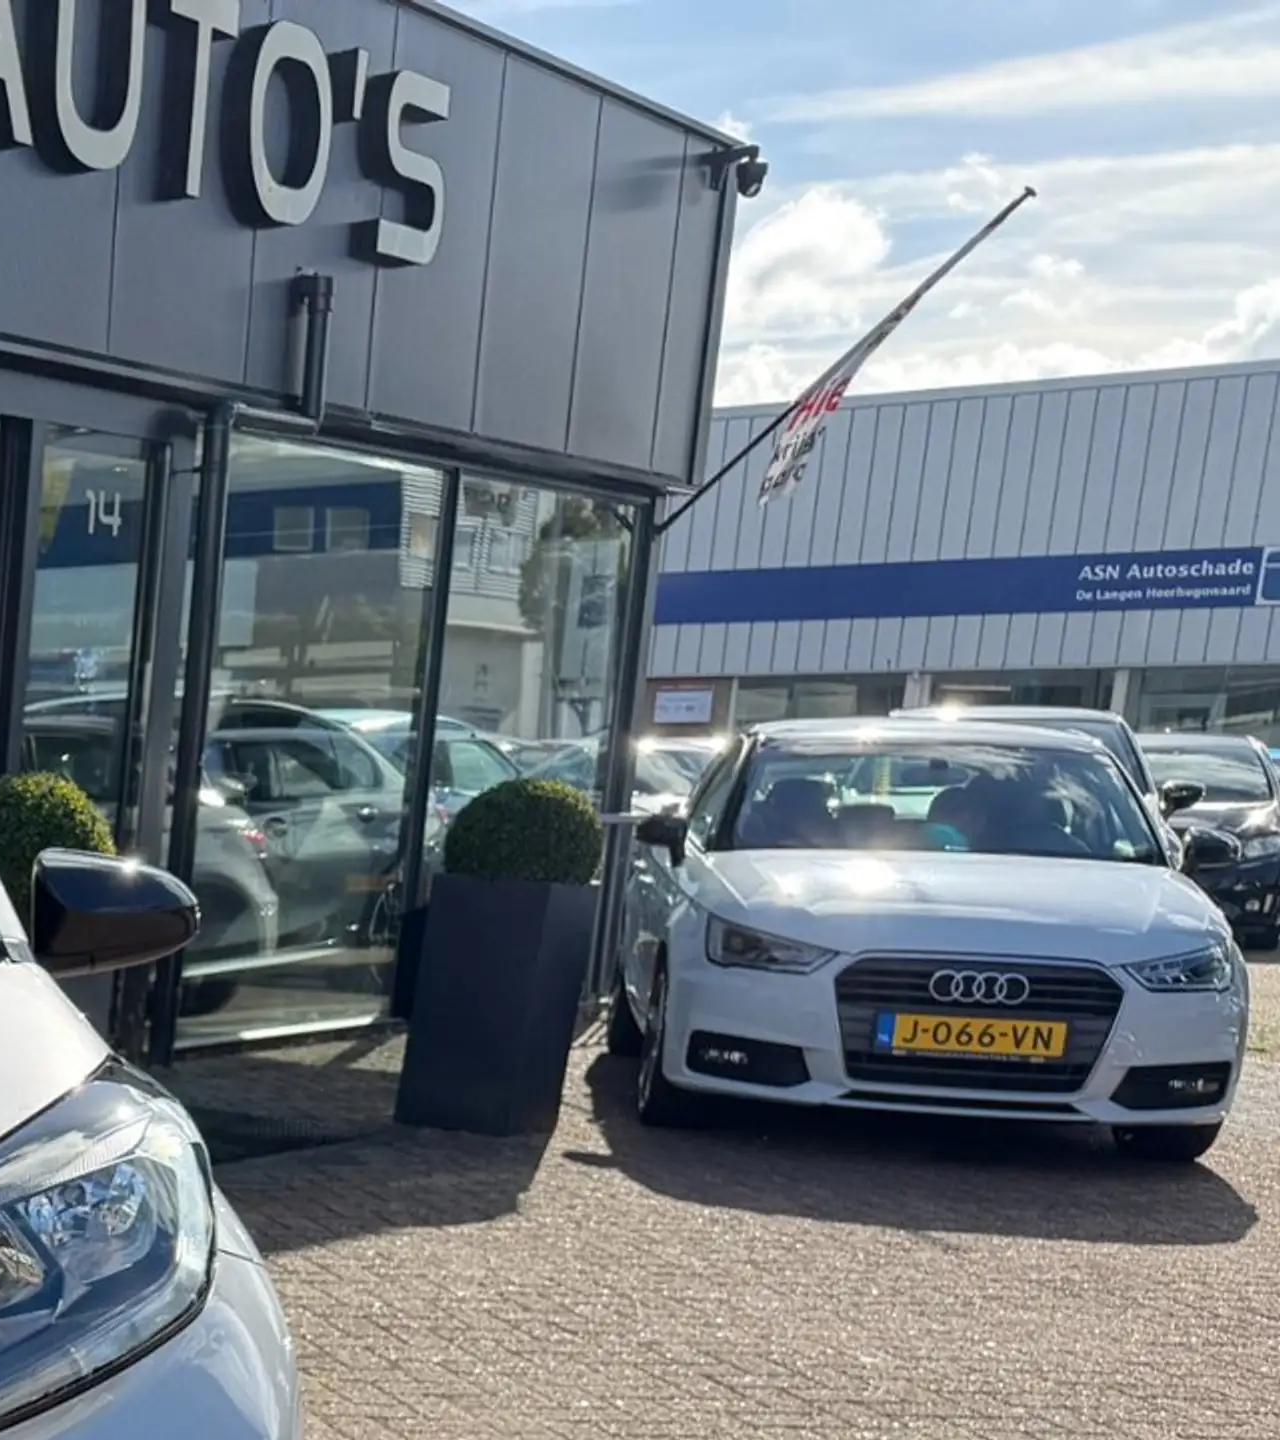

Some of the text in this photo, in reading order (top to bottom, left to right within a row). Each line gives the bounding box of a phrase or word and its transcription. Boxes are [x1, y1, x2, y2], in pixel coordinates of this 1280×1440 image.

[85, 488, 122, 537] 14
[1078, 558, 1255, 581] ASN Autoschade
[1076, 587, 1093, 601] De
[901, 1019, 1054, 1051] J-066-VN
